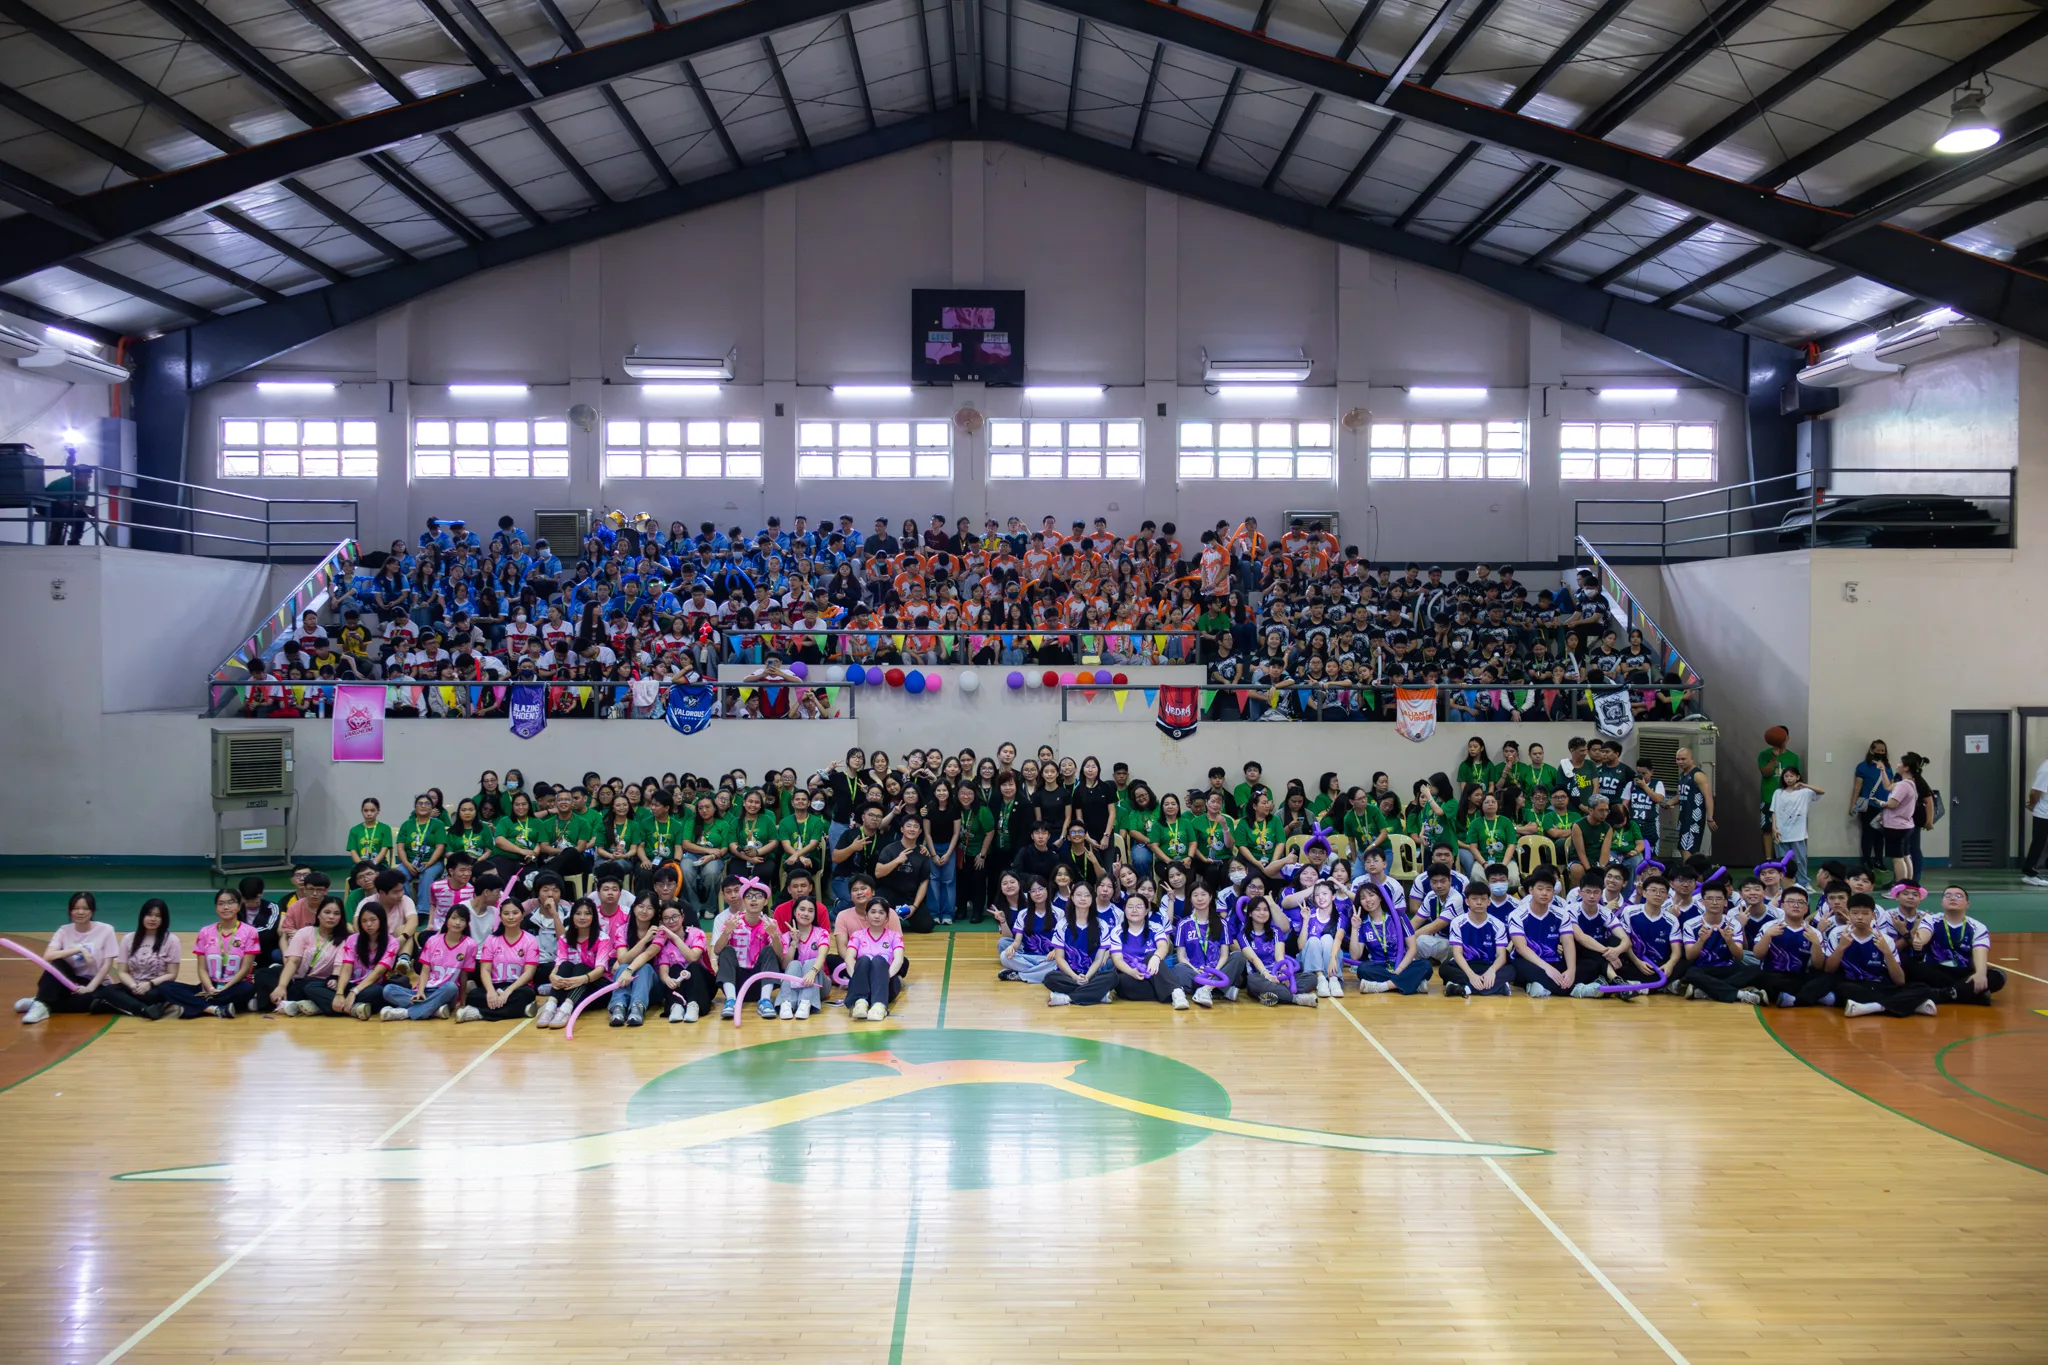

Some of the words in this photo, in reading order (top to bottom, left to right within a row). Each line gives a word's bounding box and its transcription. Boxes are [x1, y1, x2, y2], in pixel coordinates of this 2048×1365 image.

[513, 703, 540, 712] BLAZING
[674, 707, 705, 717] VALOROUS
[1633, 809, 1646, 820] 24
[1187, 930, 1196, 939] 27
[1365, 931, 1374, 940] 16
[206, 954, 241, 980] 09
